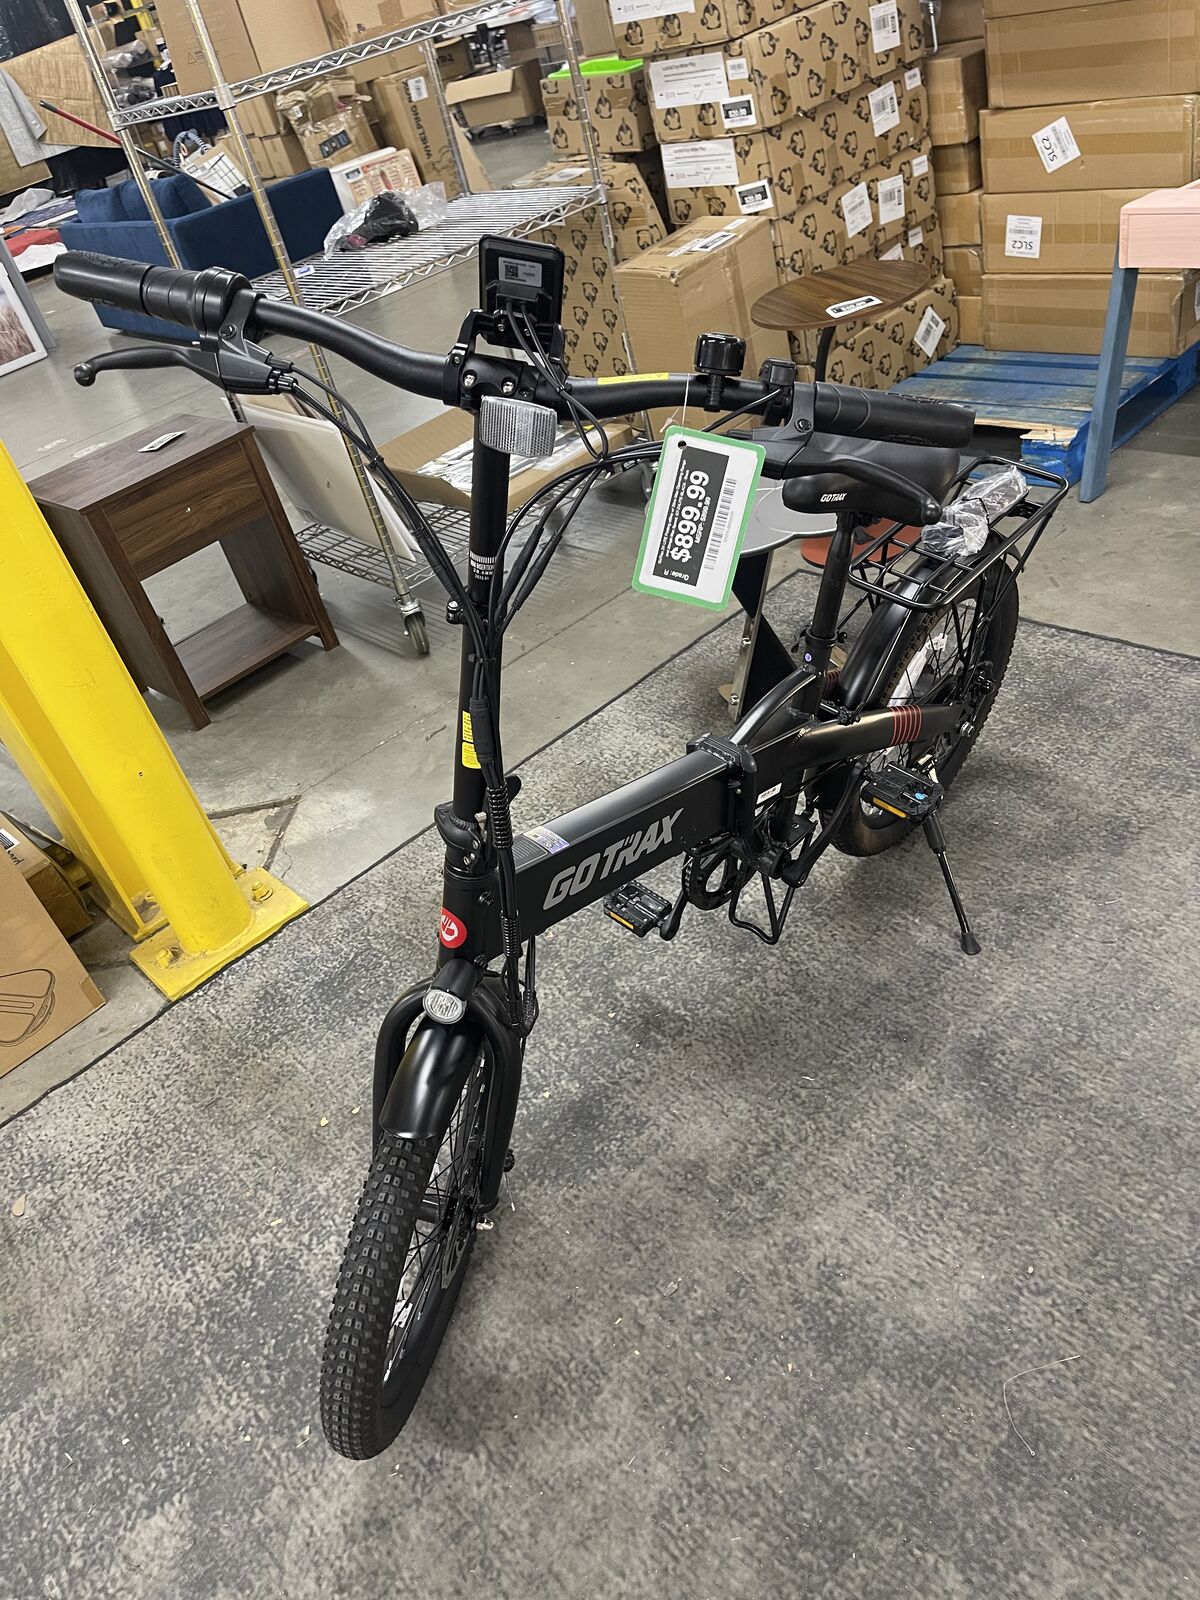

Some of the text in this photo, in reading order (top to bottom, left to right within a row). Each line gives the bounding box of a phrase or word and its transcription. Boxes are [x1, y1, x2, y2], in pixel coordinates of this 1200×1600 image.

[410, 105, 432, 159] WHELPING
[1041, 136, 1058, 162] SLC2
[1012, 239, 1033, 250] SLC2
[820, 492, 848, 502] GOTRAX
[670, 470, 709, 563] $899.99
[670, 571, 689, 581] Grade:
[542, 807, 684, 911] GOTRAX
